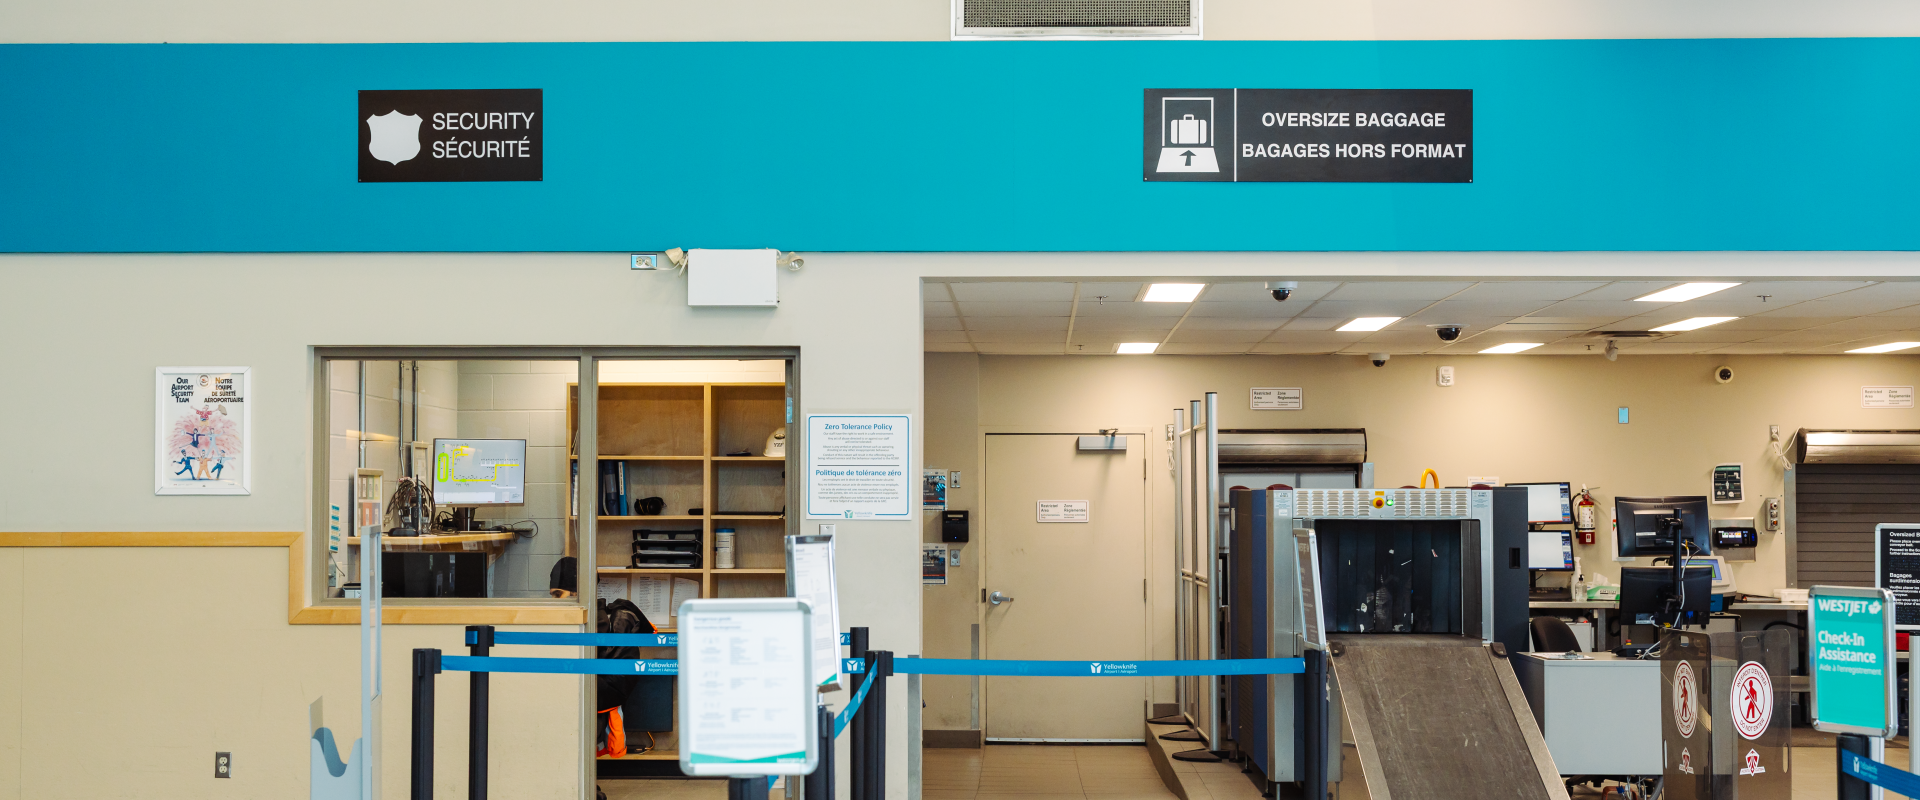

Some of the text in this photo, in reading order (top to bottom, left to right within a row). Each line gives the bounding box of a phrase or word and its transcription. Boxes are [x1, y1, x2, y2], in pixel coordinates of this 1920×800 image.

[432, 112, 535, 130] SECURITY
[1262, 112, 1446, 128] OVERSIZE BAGGAGE
[432, 136, 530, 158] SÉCURITÉ
[1242, 143, 1466, 158] BAGAGES HORS FORMAT
[1818, 599, 1868, 616] WESTJET
[1818, 630, 1865, 646] Check-In
[1819, 647, 1876, 663] Assistance
